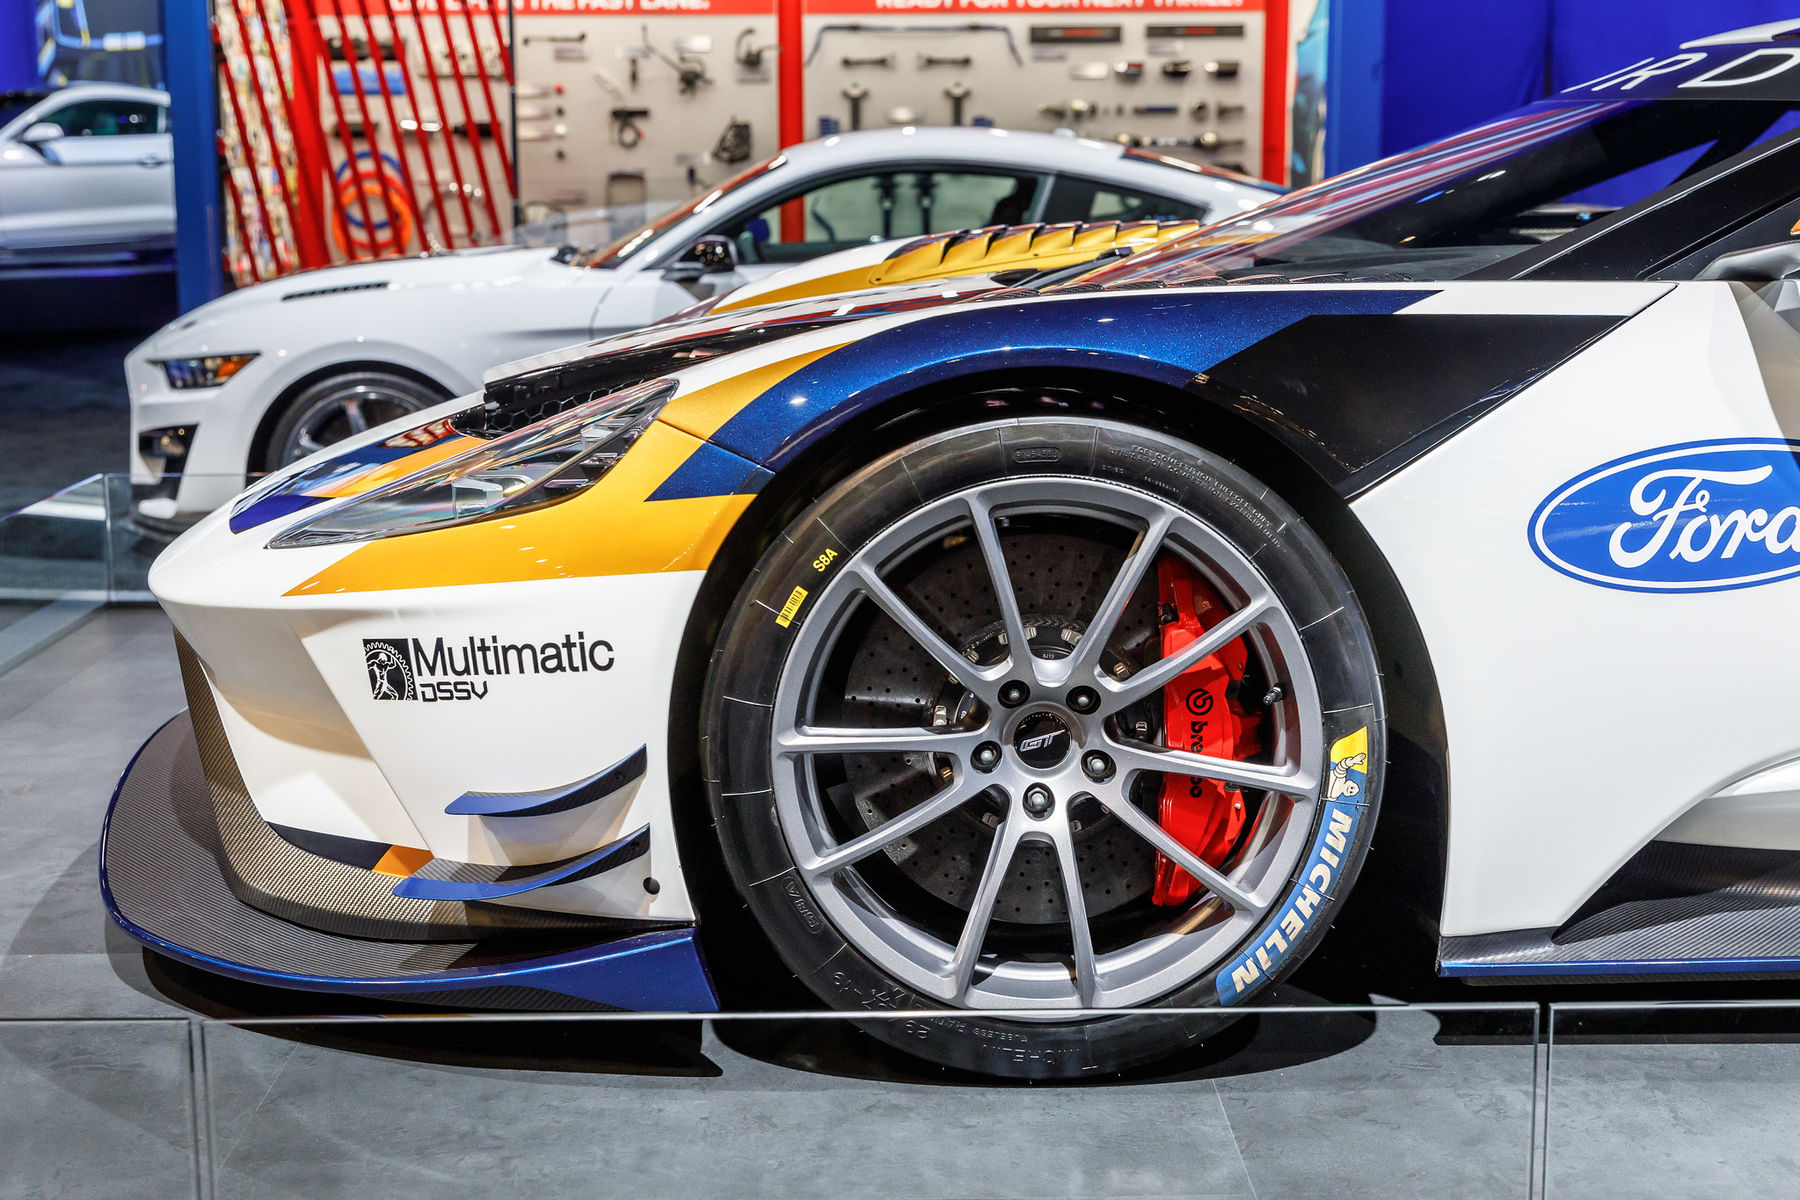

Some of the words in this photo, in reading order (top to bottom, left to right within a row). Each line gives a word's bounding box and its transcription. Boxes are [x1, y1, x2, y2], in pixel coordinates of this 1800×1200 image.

[812, 548, 838, 572] S8A
[412, 631, 615, 677] Multimatic
[419, 680, 489, 702] DSSV
[1020, 729, 1066, 752] GT
[1231, 808, 1354, 993] MICHELIN
